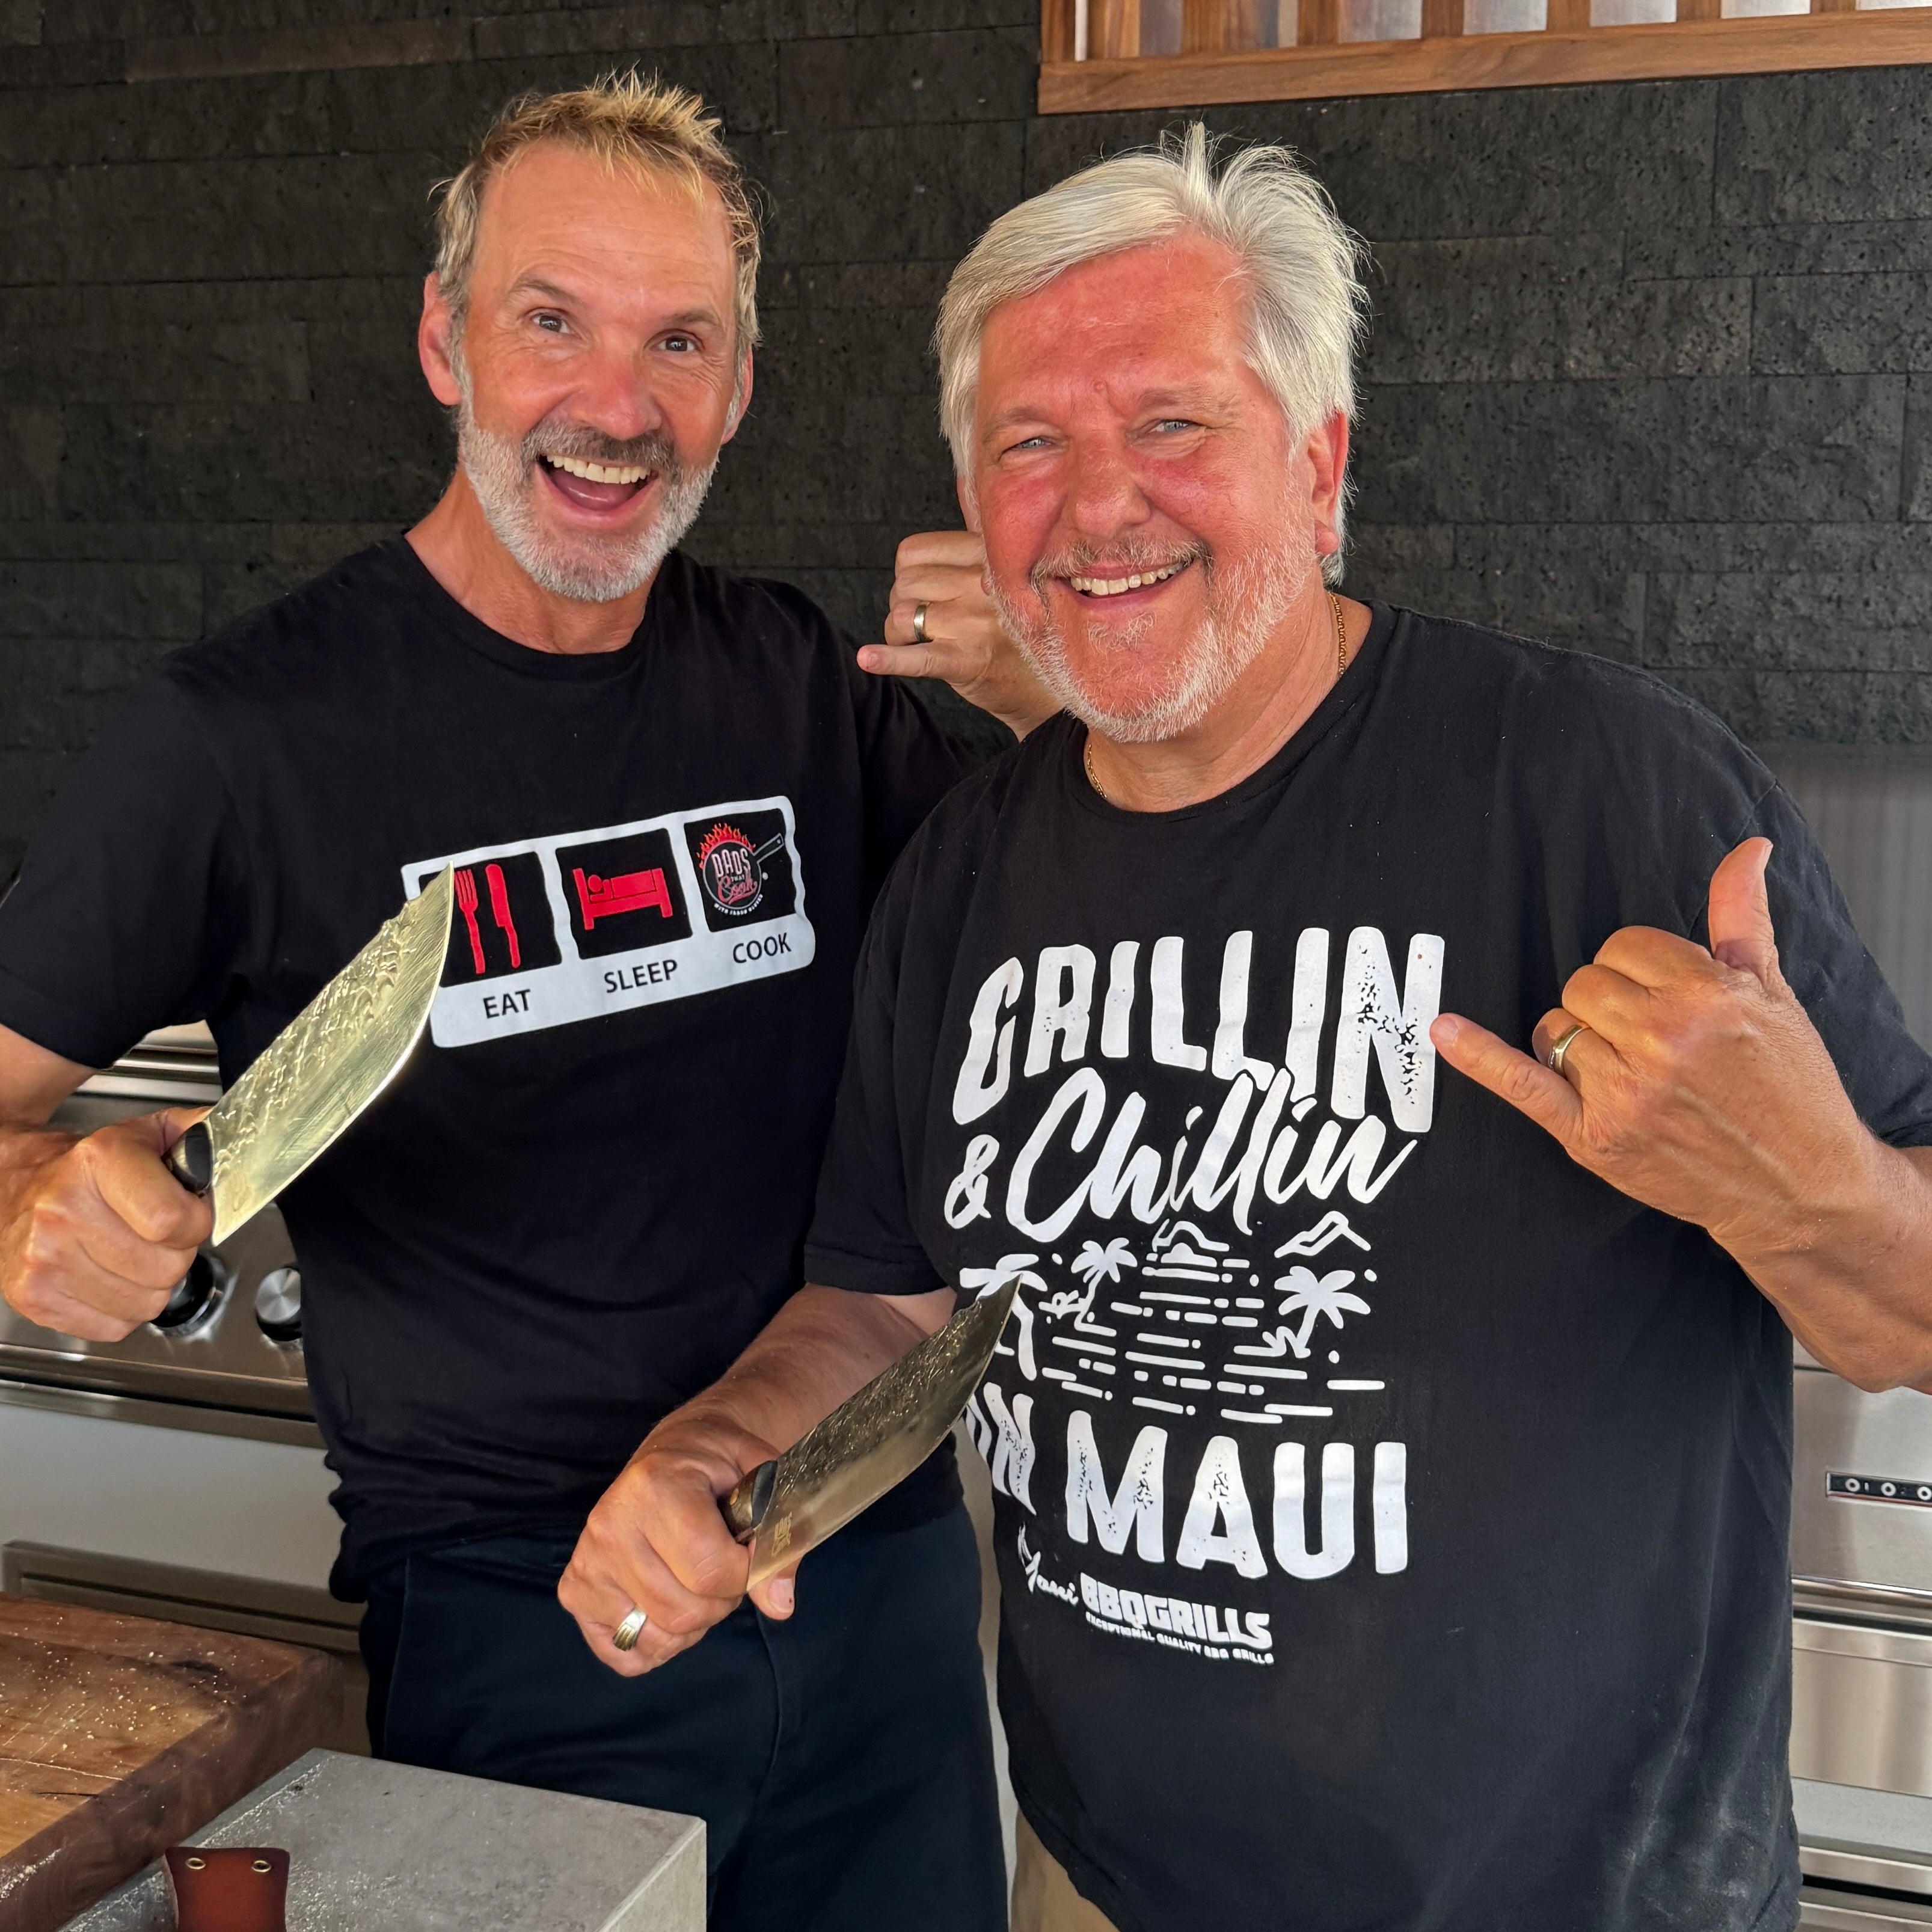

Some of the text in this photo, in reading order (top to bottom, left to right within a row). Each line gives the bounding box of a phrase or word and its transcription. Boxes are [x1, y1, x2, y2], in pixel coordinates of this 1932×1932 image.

[711, 847, 751, 878] DADS
[482, 932, 792, 1019] EAT SLEEP COOK
[952, 926, 1445, 1133] GRILLIN
[943, 1067, 1418, 1244] & Chillin
[1065, 1409, 1408, 1580] MAUI
[1156, 1633, 1202, 1656] QUALITY
